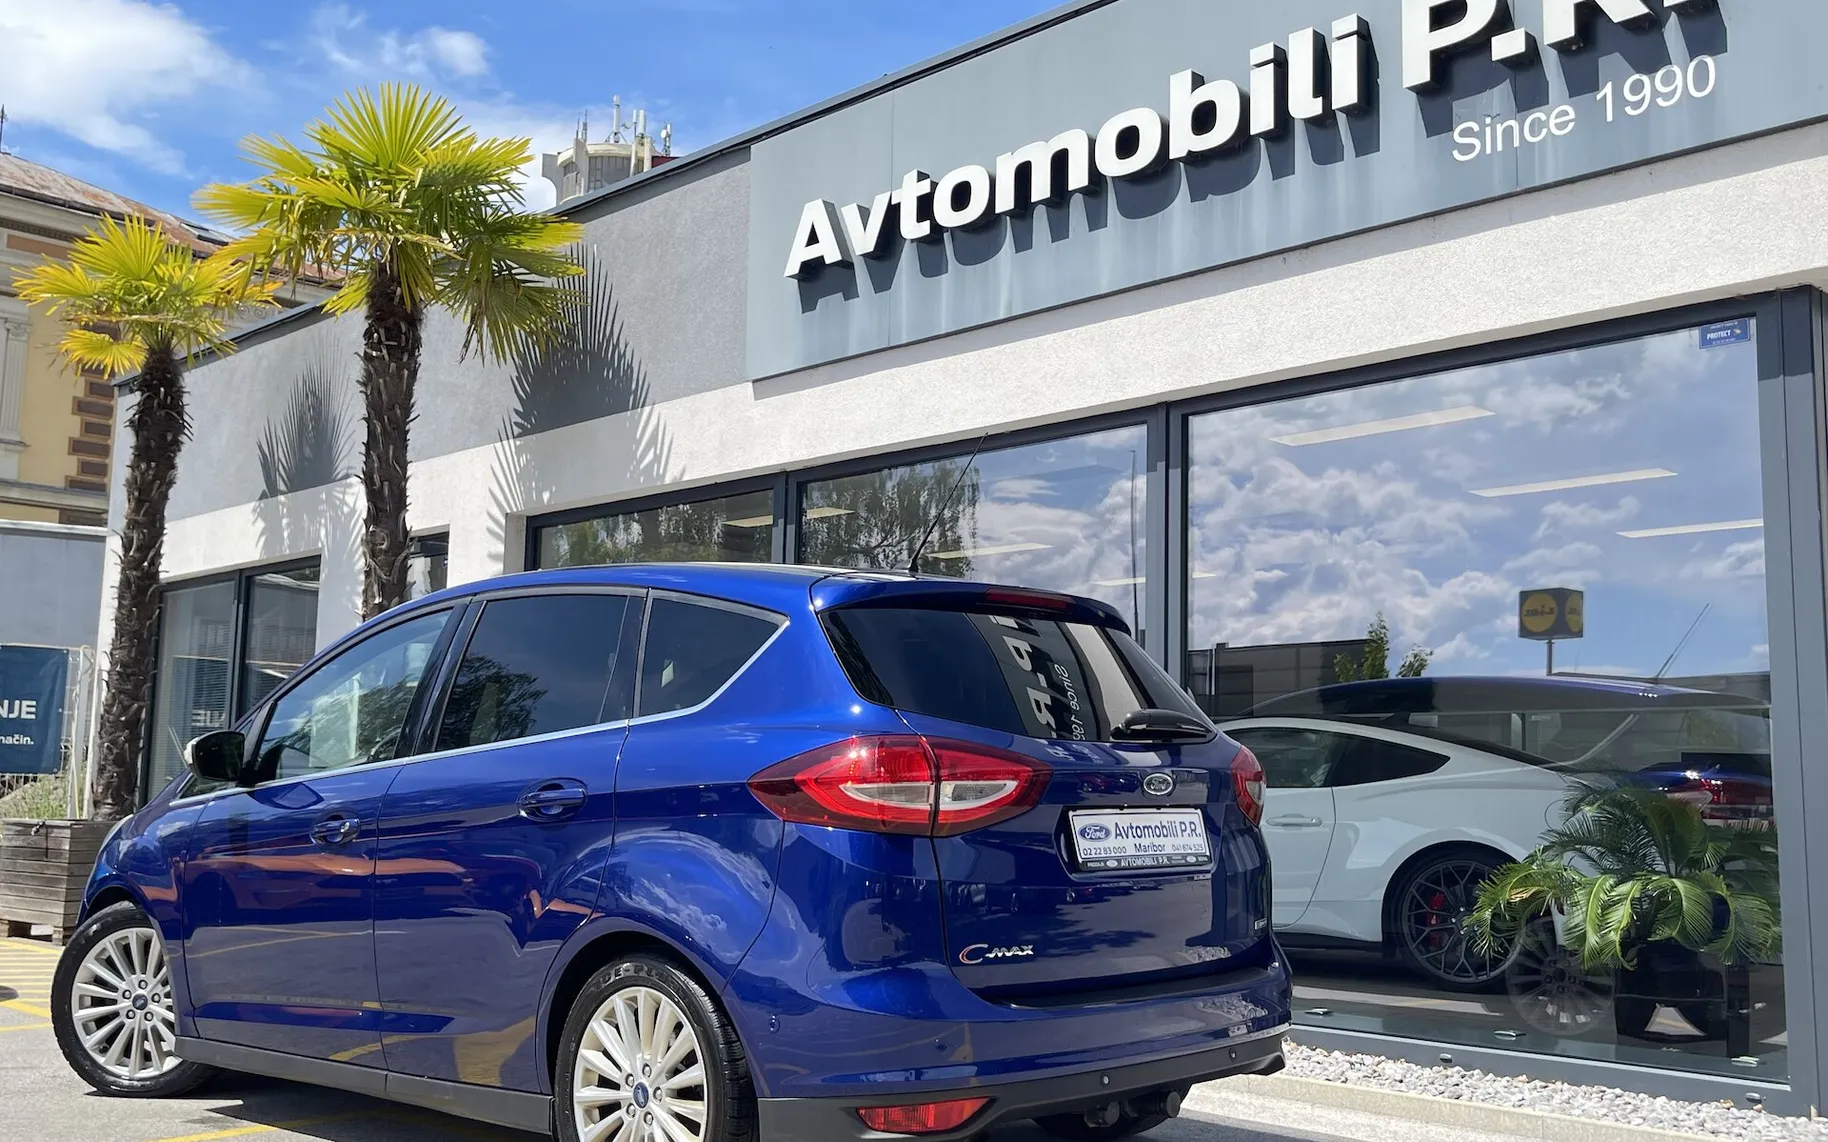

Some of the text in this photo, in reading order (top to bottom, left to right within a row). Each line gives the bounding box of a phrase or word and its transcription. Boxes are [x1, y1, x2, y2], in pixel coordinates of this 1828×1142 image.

[1452, 55, 1717, 162] Since 1990
[784, 0, 1690, 280] Avtomobili P.
[1706, 329, 1732, 340] PROTECT
[1083, 821, 1202, 841] Ford Avtomobili P.R.
[1134, 842, 1166, 853] Maribor
